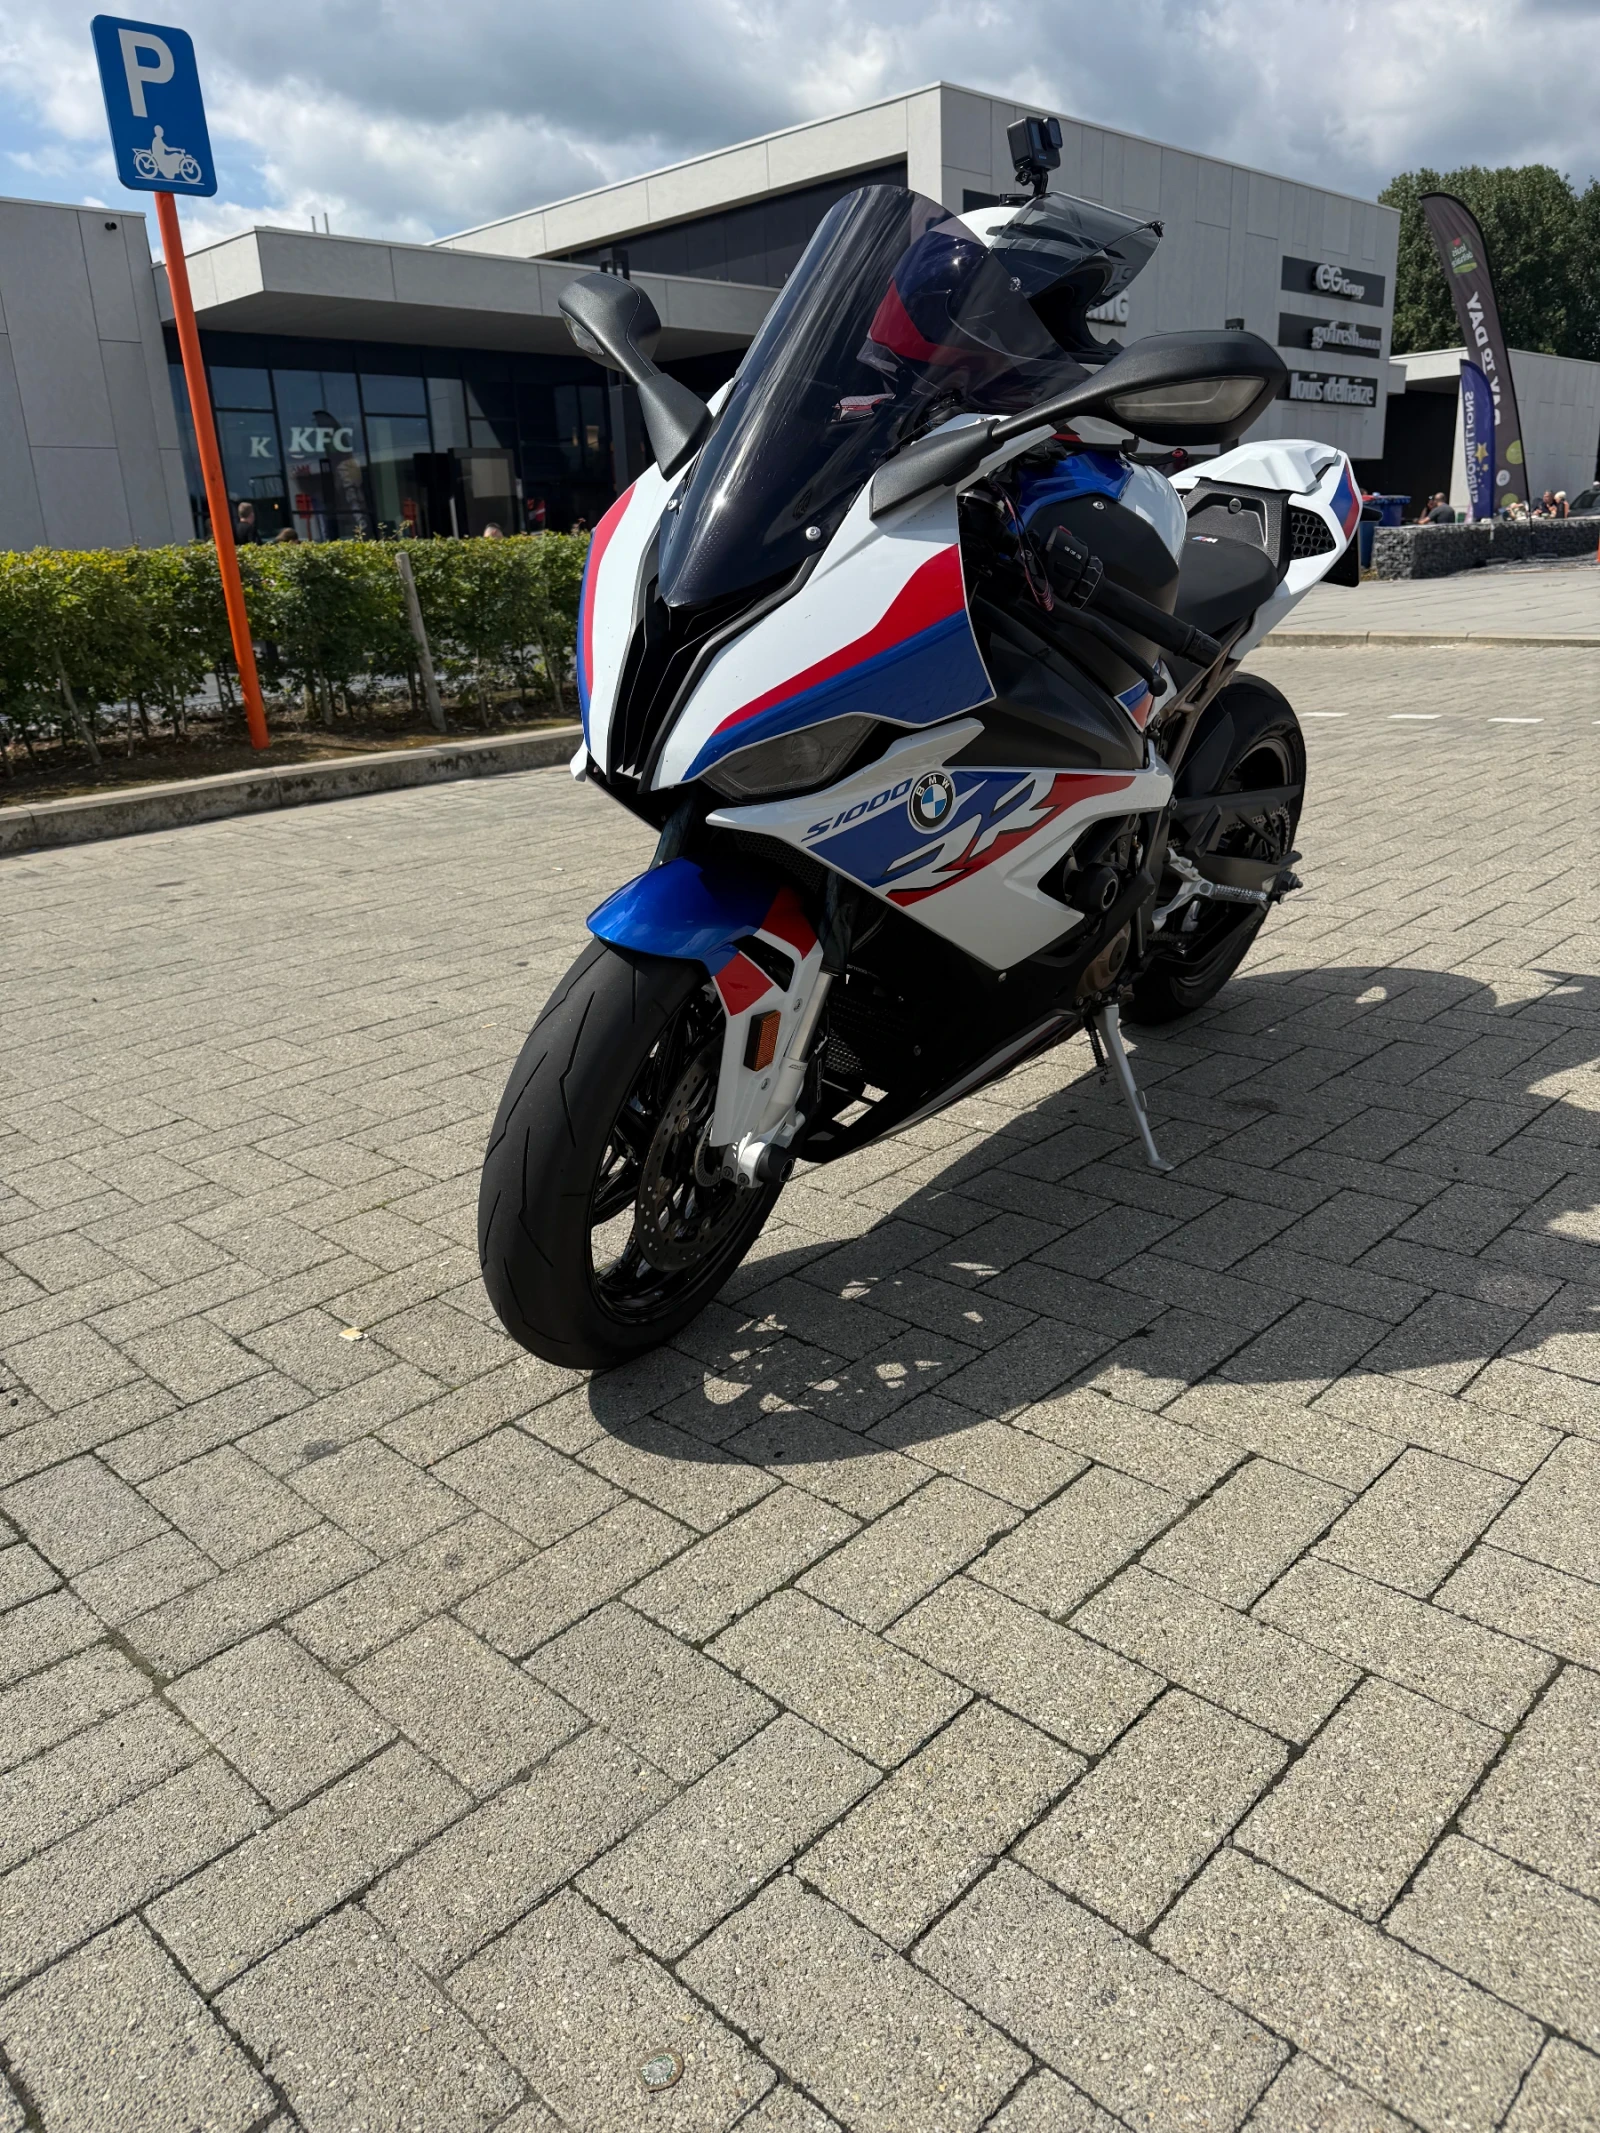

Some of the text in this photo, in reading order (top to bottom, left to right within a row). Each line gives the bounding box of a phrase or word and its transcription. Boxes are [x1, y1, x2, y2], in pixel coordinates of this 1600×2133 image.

[117, 27, 175, 118] P
[1343, 279, 1365, 300] Group
[1289, 372, 1375, 405] louis delhaize
[288, 427, 353, 453] KFC
[915, 775, 949, 797] BMW
[801, 777, 913, 842] S1000
